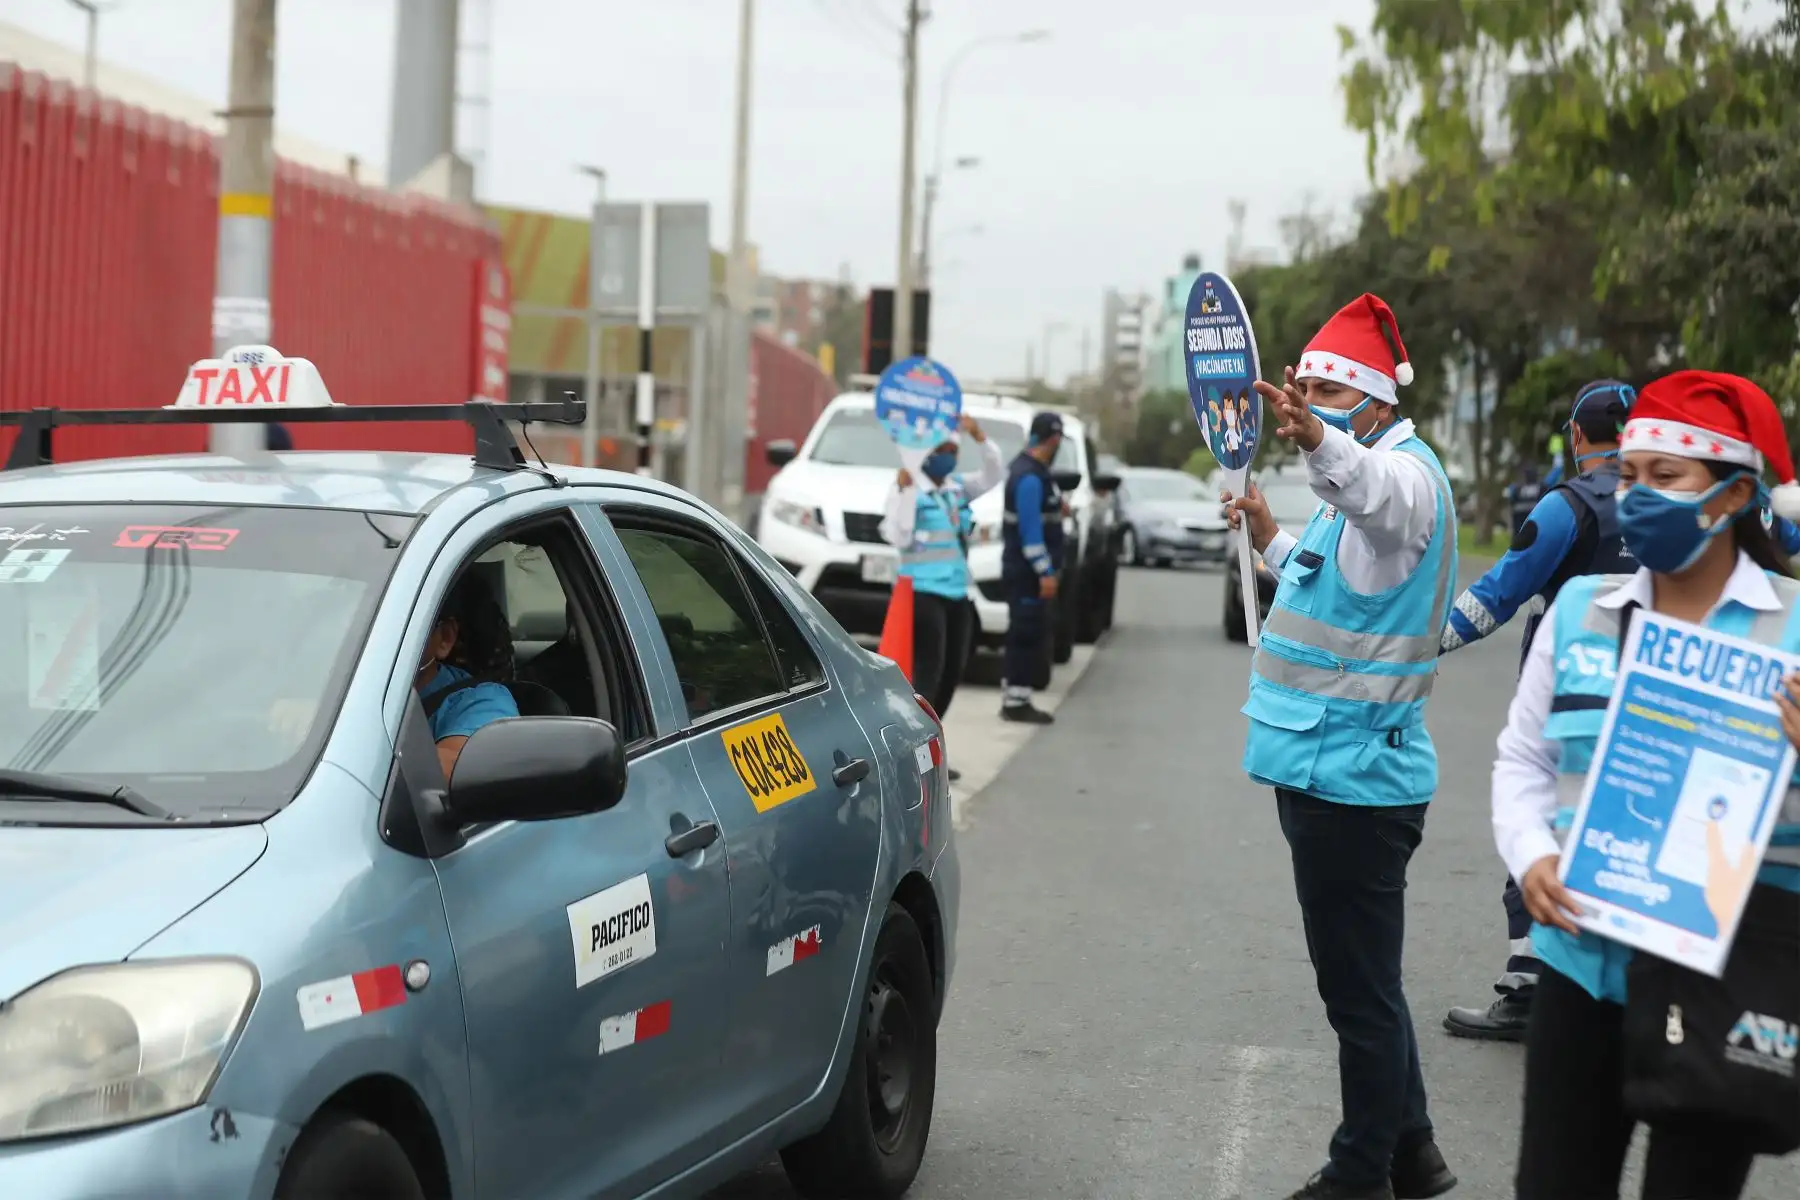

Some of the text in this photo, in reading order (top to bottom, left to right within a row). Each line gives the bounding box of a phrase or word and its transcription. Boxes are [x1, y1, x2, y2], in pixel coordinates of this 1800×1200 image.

[1187, 325, 1246, 351] SEGUNDA DOSIS
[192, 364, 291, 405] TAXI
[1196, 356, 1245, 379] ¡VACÚNATE YA!
[1635, 620, 1800, 702] RECUERD
[591, 900, 650, 953] PACIFICO
